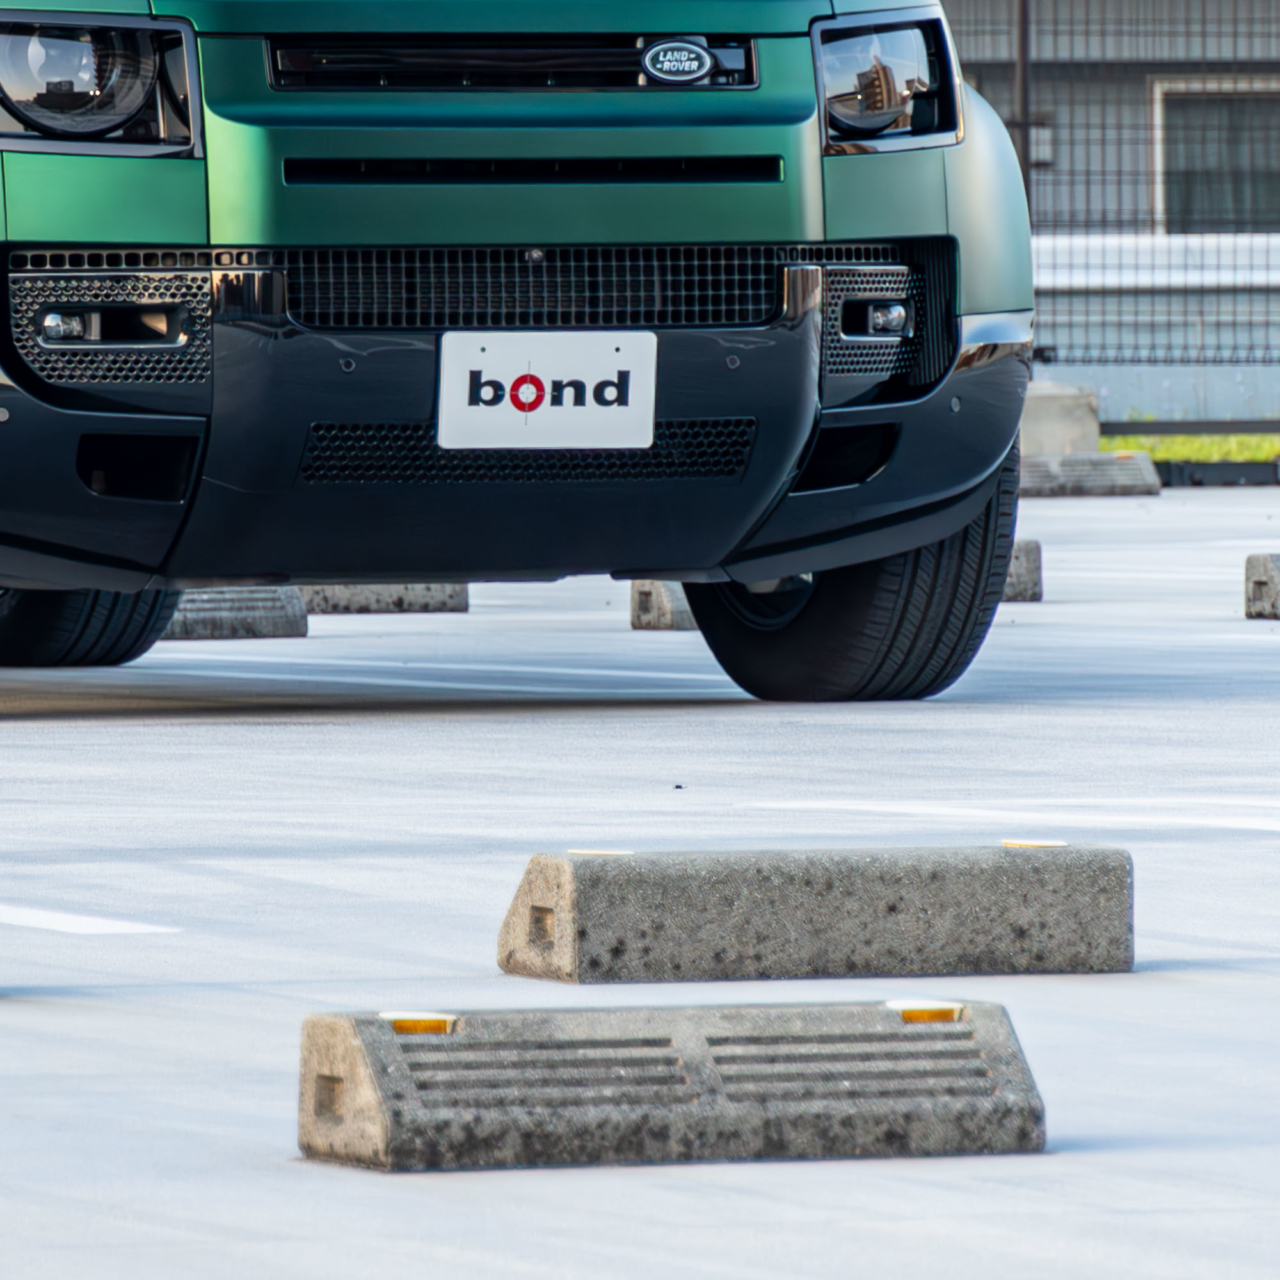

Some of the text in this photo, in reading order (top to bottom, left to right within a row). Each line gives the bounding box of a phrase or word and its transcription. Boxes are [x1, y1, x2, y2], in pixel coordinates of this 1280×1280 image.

[658, 50, 689, 62] LAND
[662, 60, 700, 72] ROVER
[467, 369, 631, 413] bond
